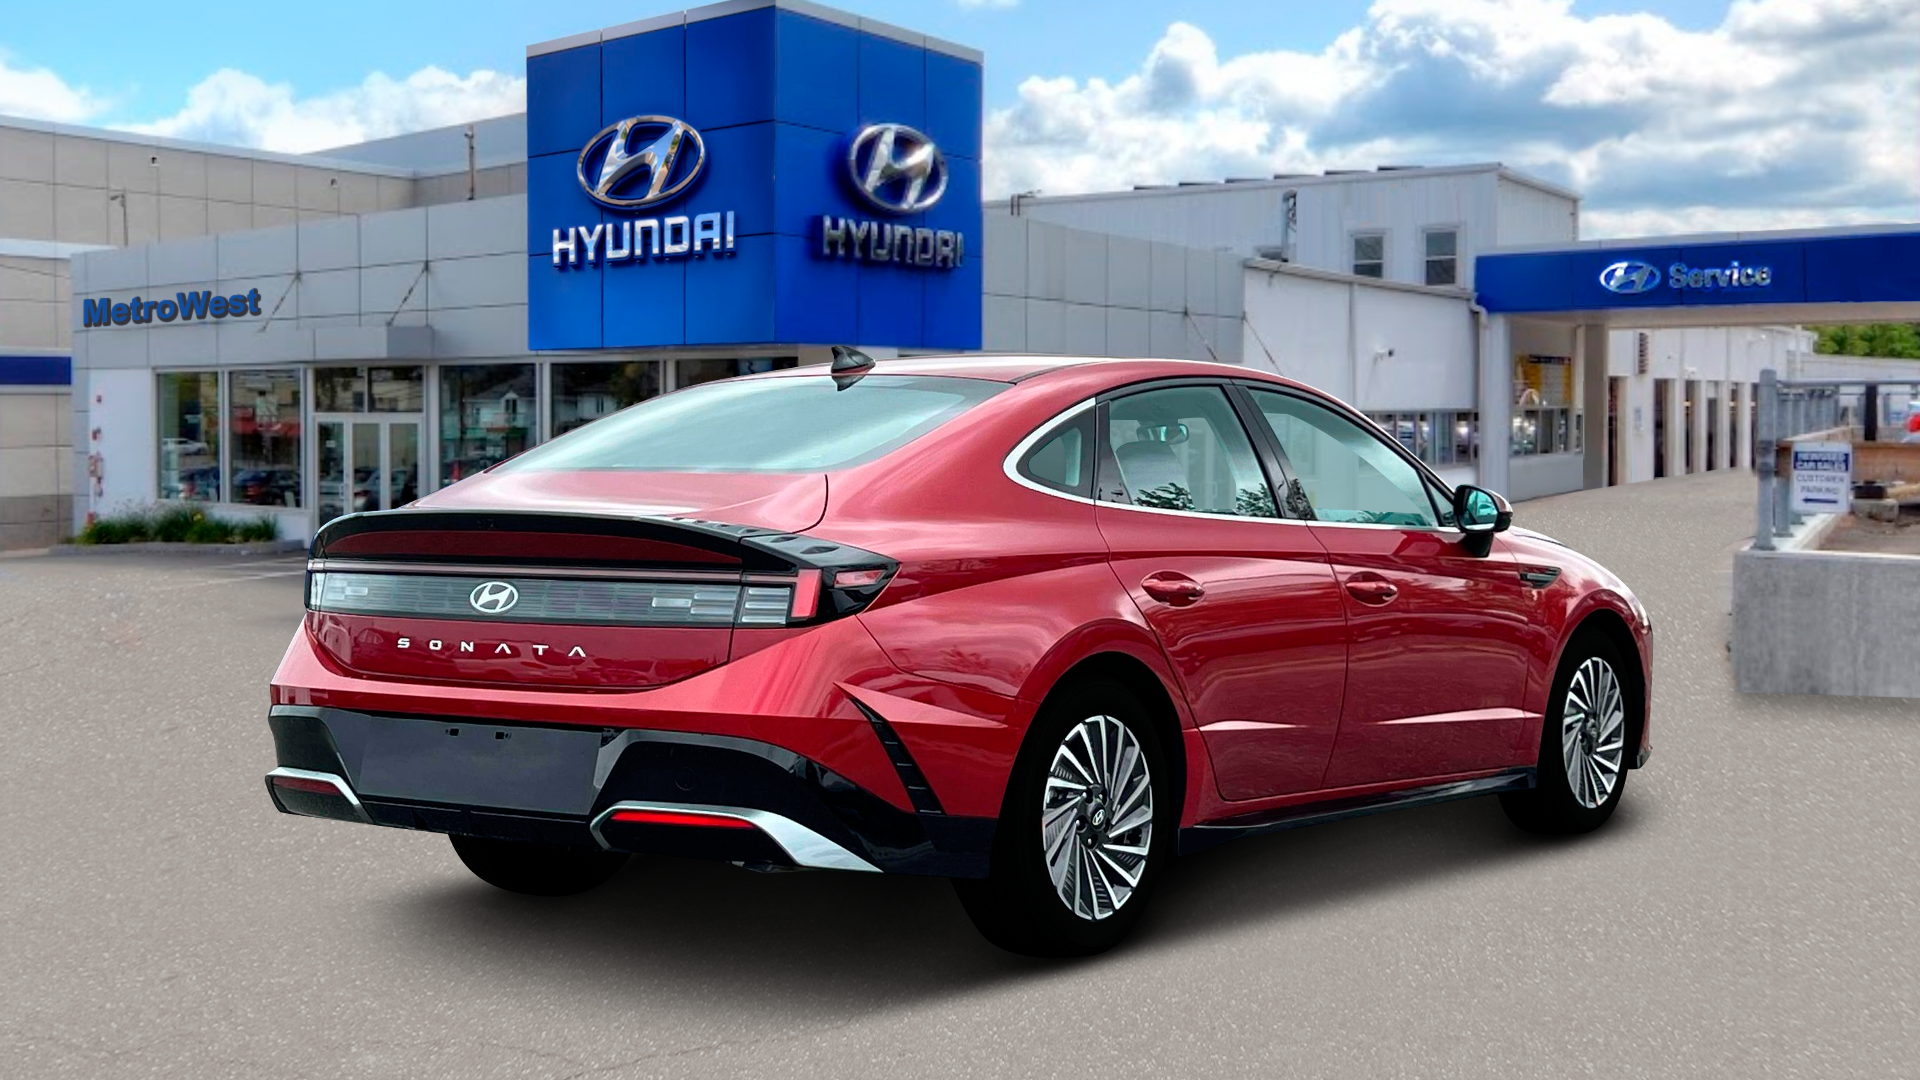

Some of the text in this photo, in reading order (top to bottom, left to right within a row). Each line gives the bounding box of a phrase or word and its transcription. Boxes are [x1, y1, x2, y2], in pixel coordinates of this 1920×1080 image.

[552, 210, 735, 265] HYUNDAI
[822, 214, 965, 268] HYUNDAI
[1669, 260, 1772, 289] Service
[83, 288, 262, 327] MetroWest
[397, 637, 587, 658] SONATA
